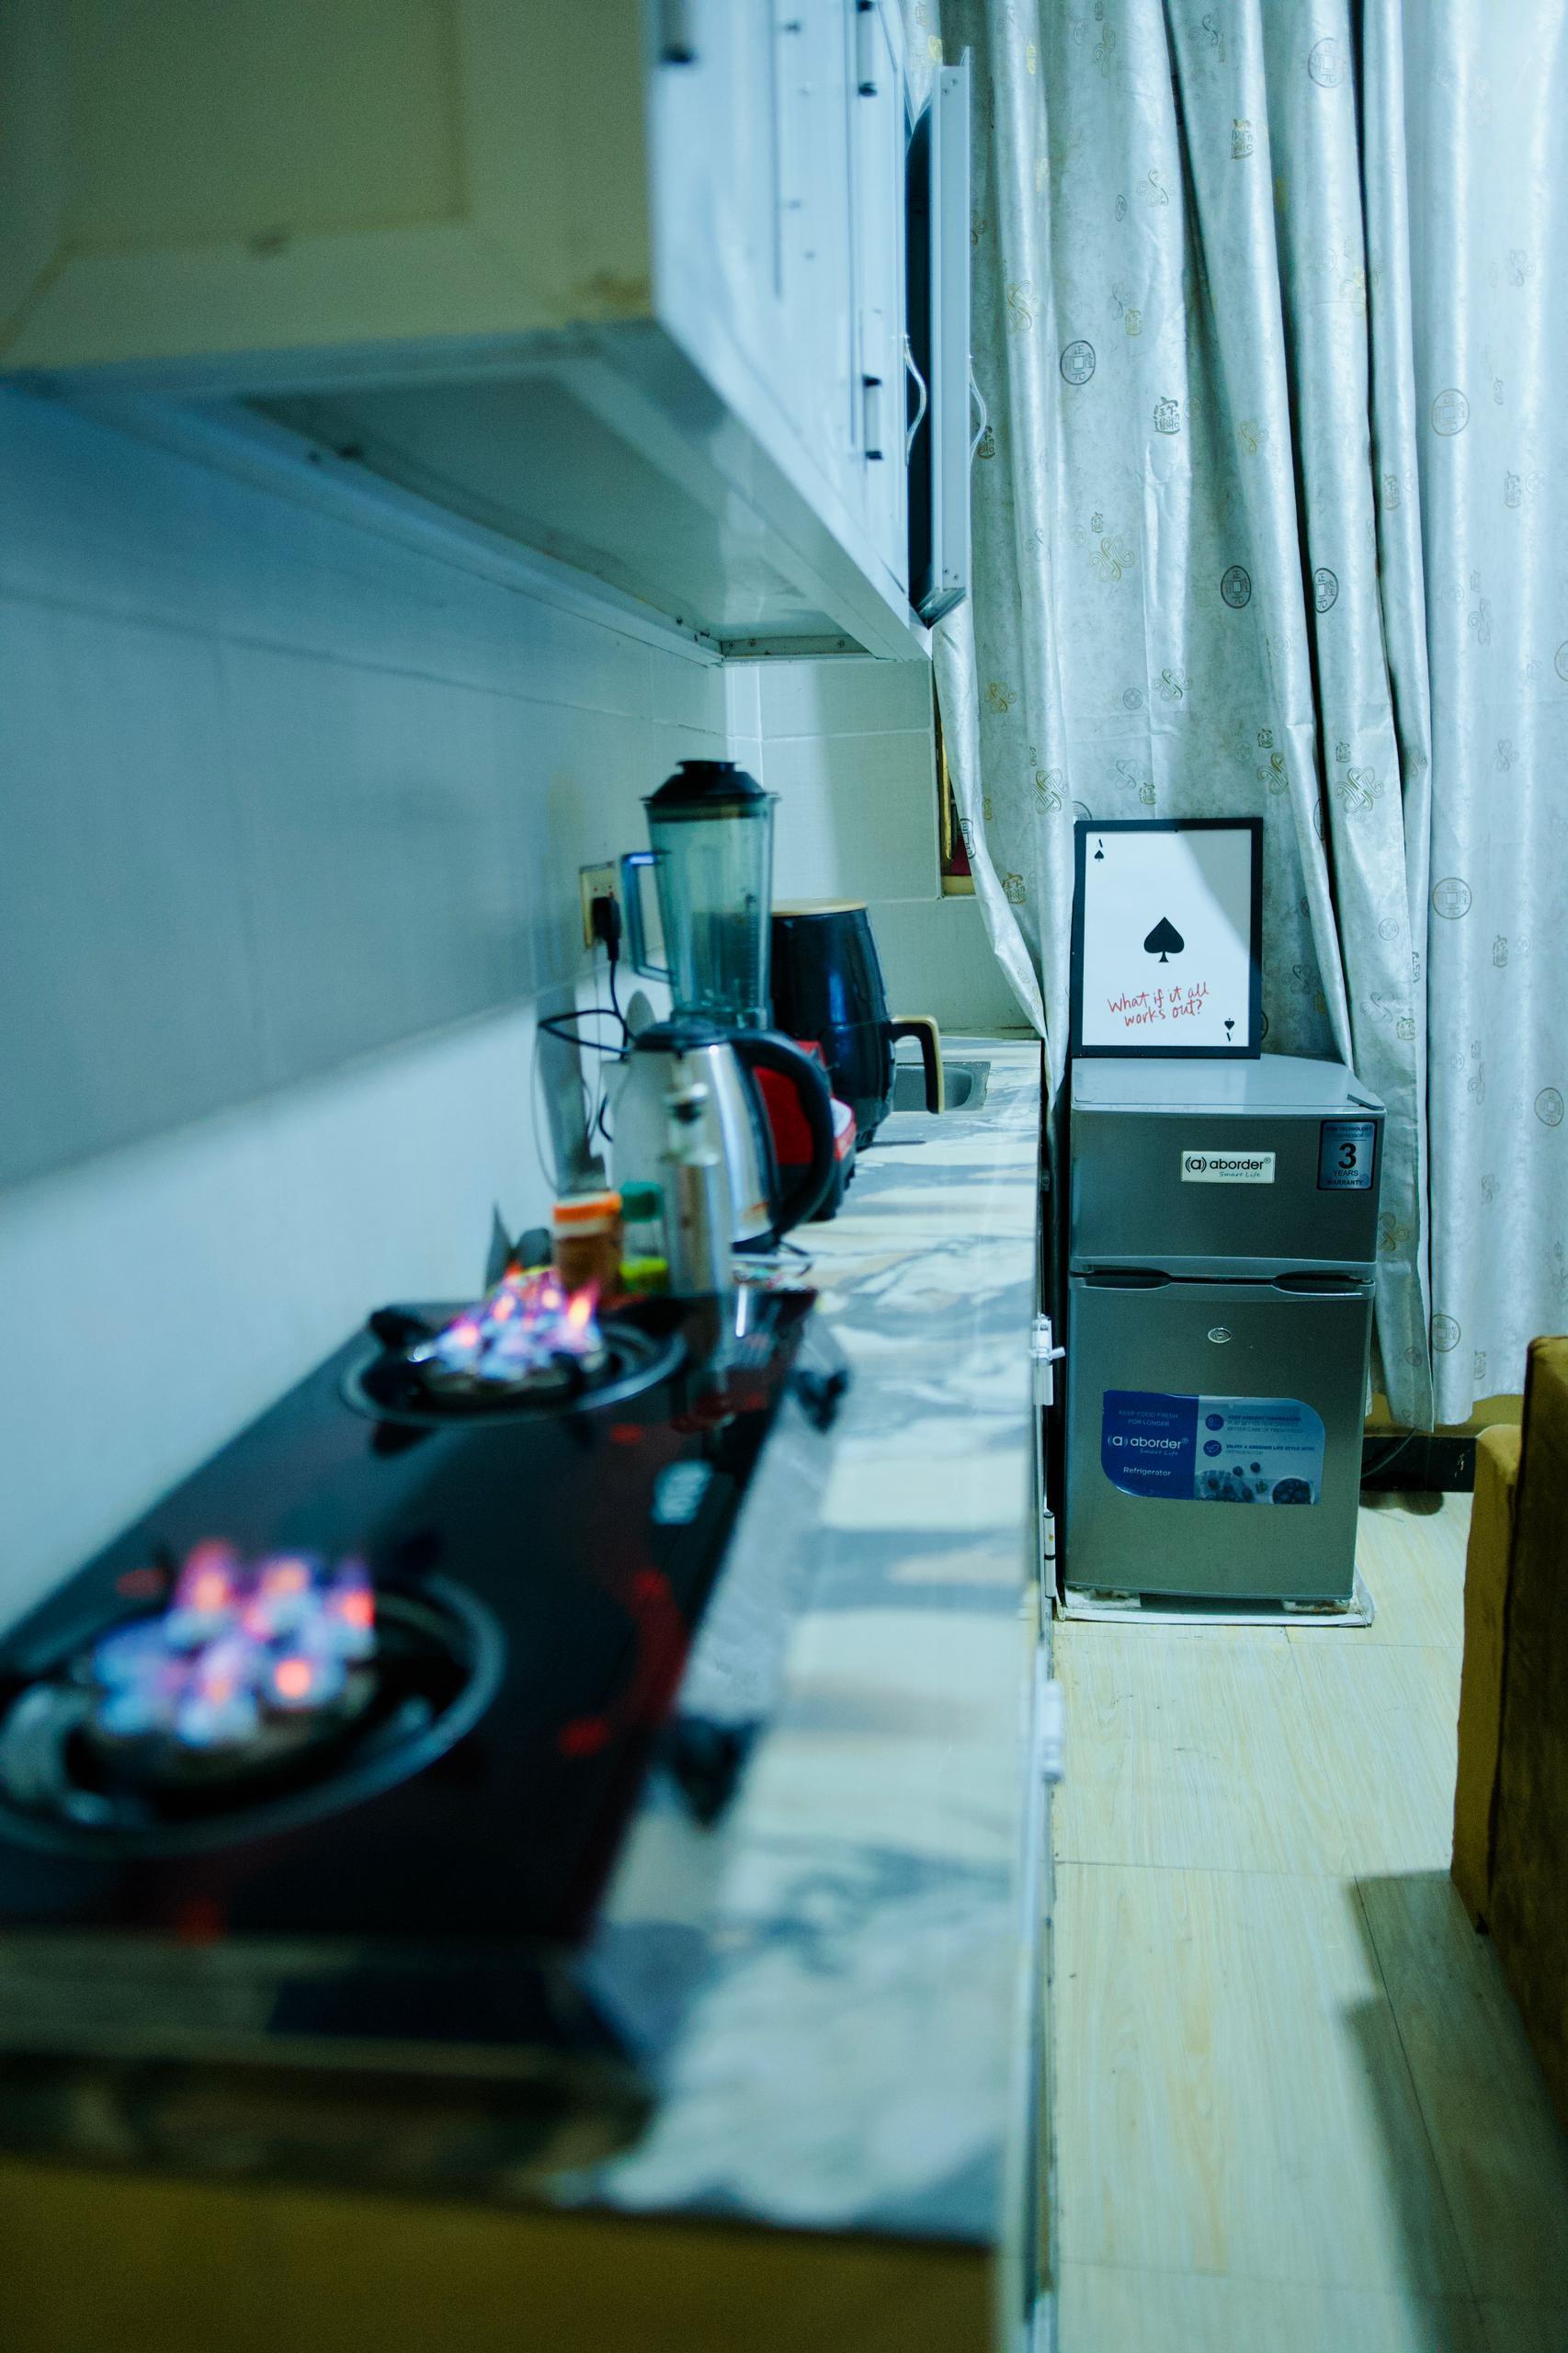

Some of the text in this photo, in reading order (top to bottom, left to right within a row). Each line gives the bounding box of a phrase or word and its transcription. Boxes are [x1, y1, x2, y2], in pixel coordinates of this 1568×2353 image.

[1108, 981, 1210, 1013] What if it all
[1124, 998, 1202, 1028] works out?
[1338, 1142, 1358, 1169] 3
[1210, 1158, 1264, 1170] aborder
[1244, 1171, 1261, 1179] Life
[1130, 1437, 1181, 1449] aborder
[1123, 1465, 1172, 1476] Refrigerator
